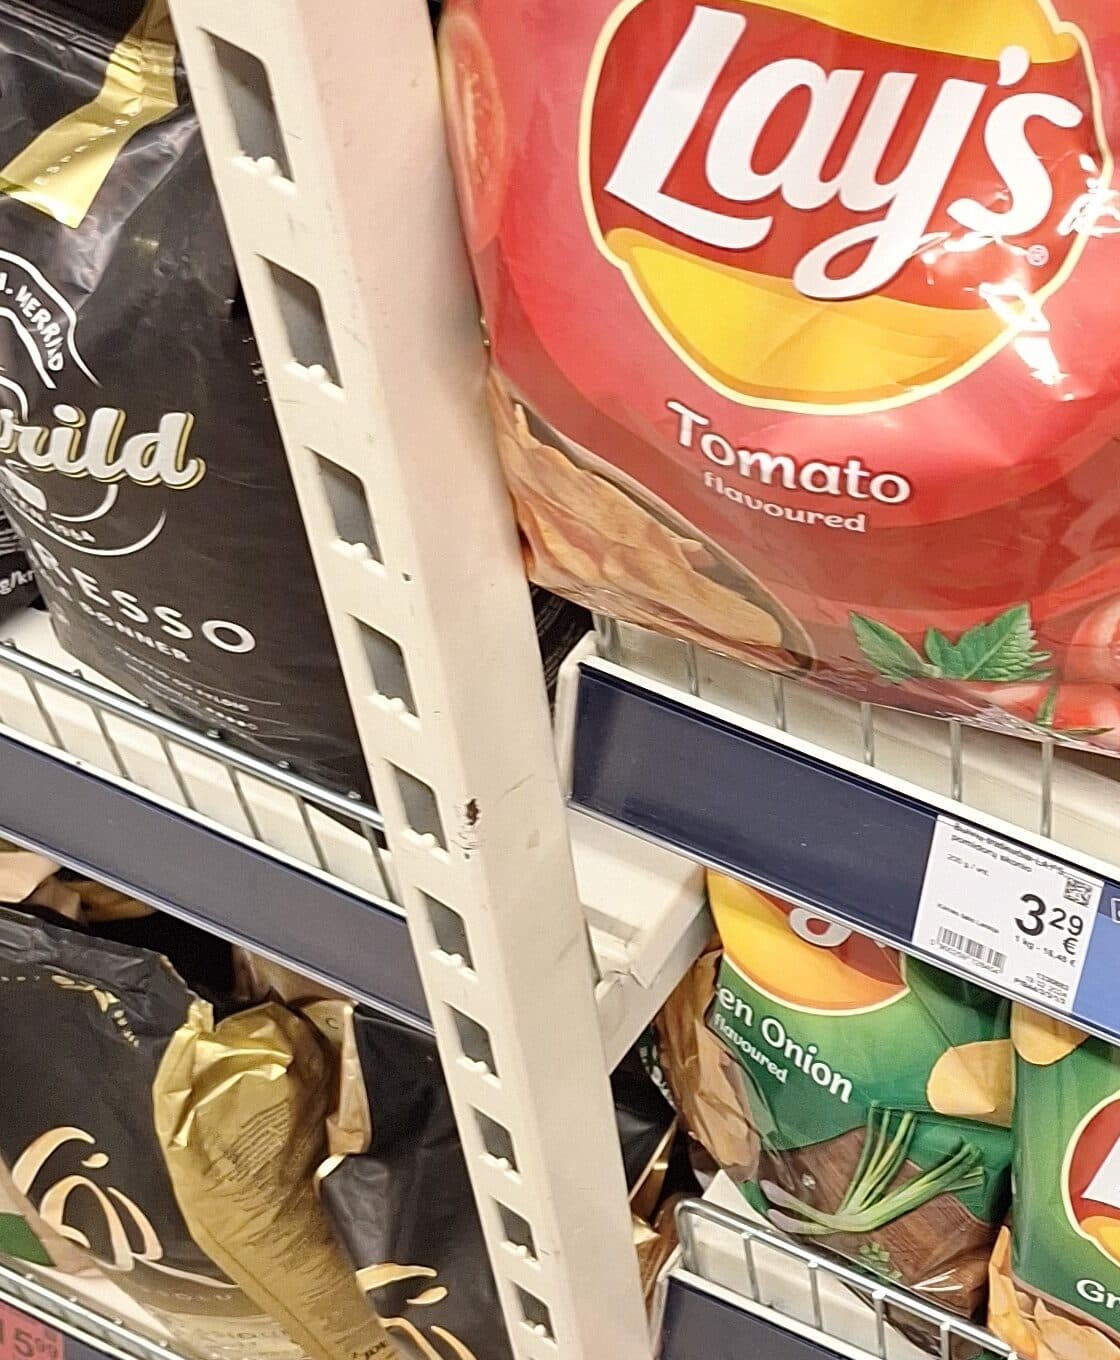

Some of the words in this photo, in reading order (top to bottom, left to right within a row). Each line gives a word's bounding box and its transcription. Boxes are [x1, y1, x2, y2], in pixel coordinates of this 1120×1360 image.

[603, 5, 1083, 300] Lay's
[666, 400, 912, 505] Tomato
[704, 471, 867, 534] flavoured
[31, 538, 256, 654] RESSO
[712, 1013, 789, 1085] flavoured
[760, 1016, 854, 1105] Onion
